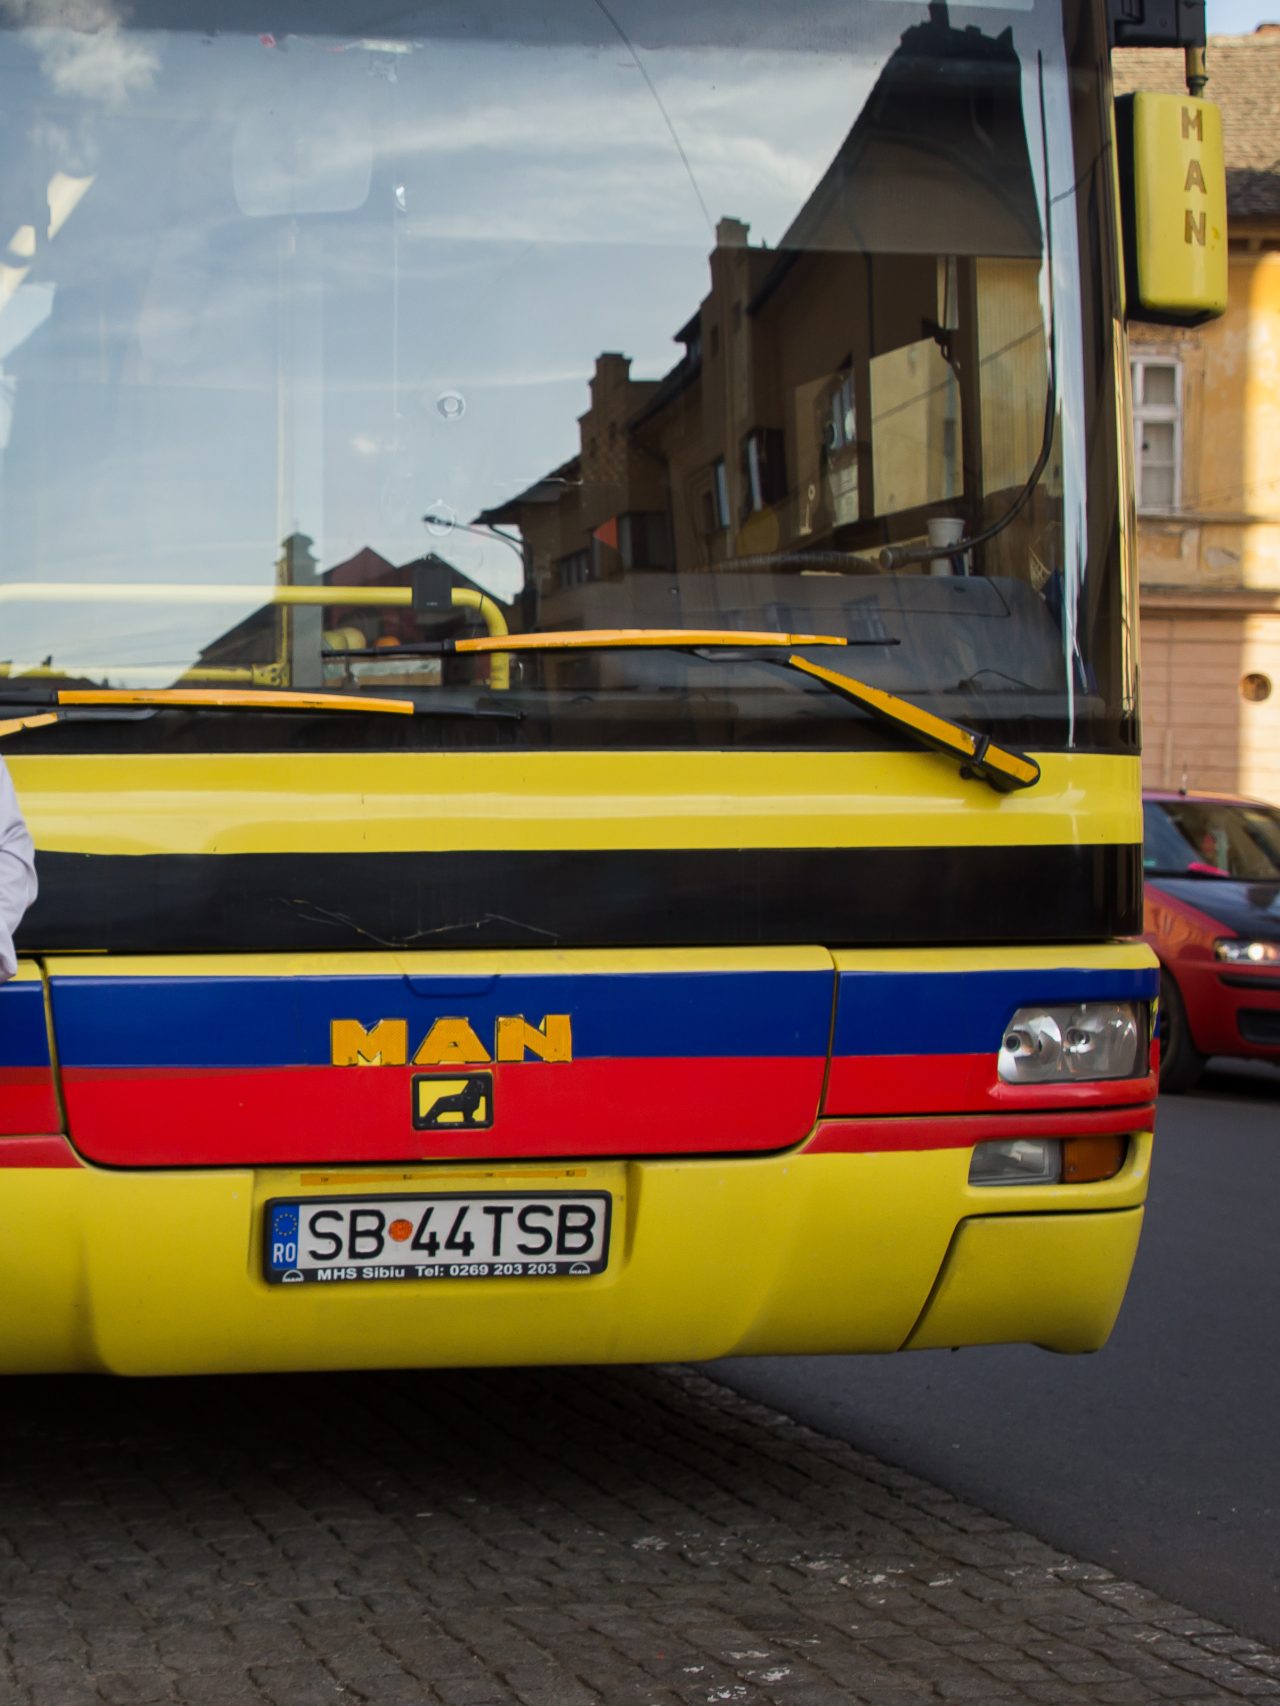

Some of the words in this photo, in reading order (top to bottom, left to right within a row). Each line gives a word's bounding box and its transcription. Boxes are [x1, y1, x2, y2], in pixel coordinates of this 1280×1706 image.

[1181, 105, 1207, 247] MAN
[330, 1013, 573, 1067] MAN
[272, 1242, 297, 1264] RO
[308, 1209, 386, 1261] SB
[317, 1269, 357, 1281] MHS
[362, 1266, 405, 1279] Sibiu
[415, 1264, 445, 1277] Tel:
[449, 1263, 489, 1277] 0269
[493, 1262, 523, 1275] 203
[527, 1262, 558, 1275] 203
